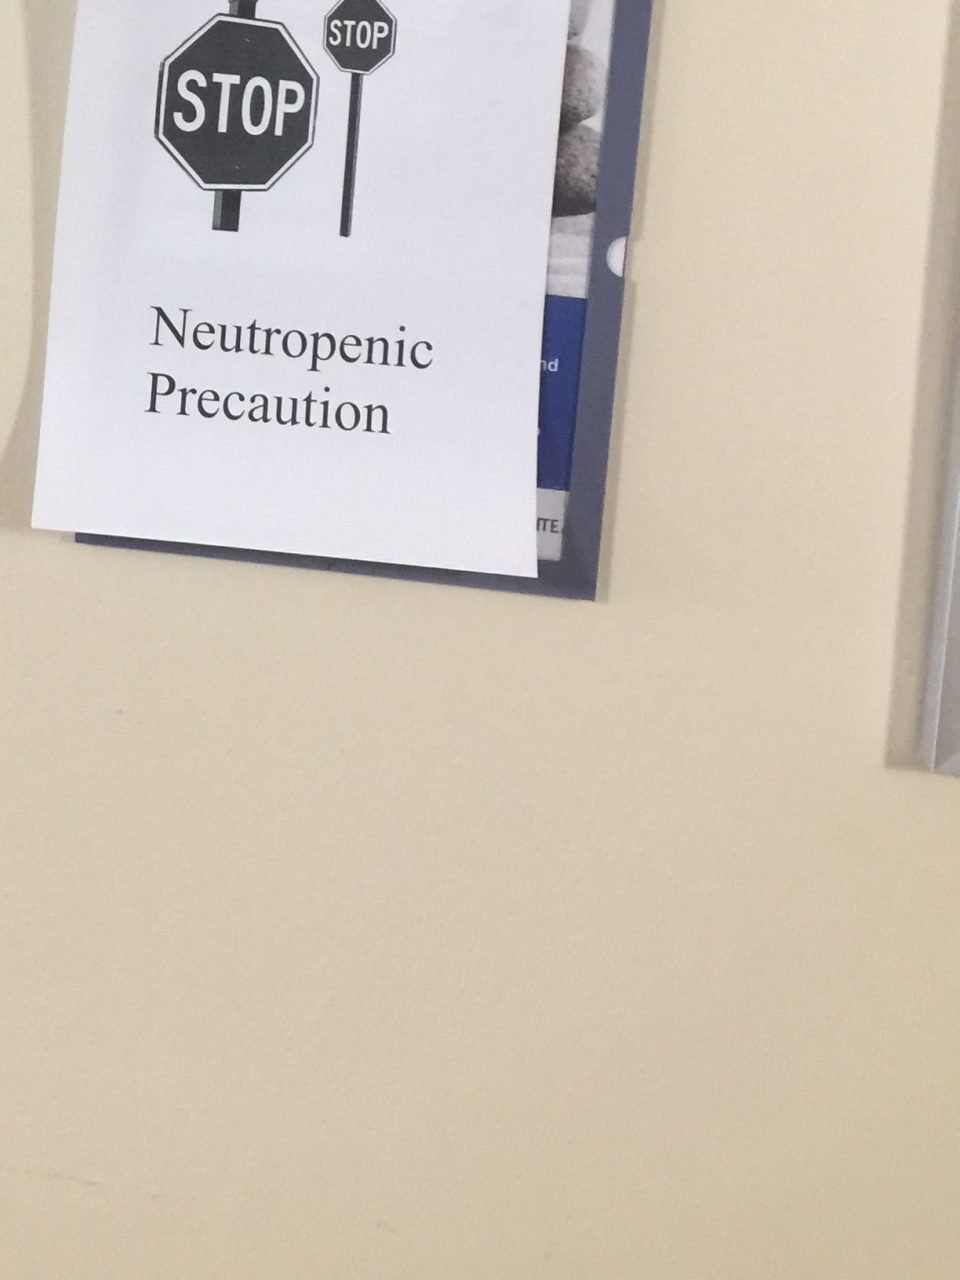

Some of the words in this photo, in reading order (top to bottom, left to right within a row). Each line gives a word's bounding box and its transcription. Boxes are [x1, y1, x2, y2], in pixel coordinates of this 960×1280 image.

[328, 19, 390, 50] STOP
[172, 68, 306, 137] STOP
[149, 305, 433, 372] Neutropenic
[144, 372, 391, 435] Precaution
